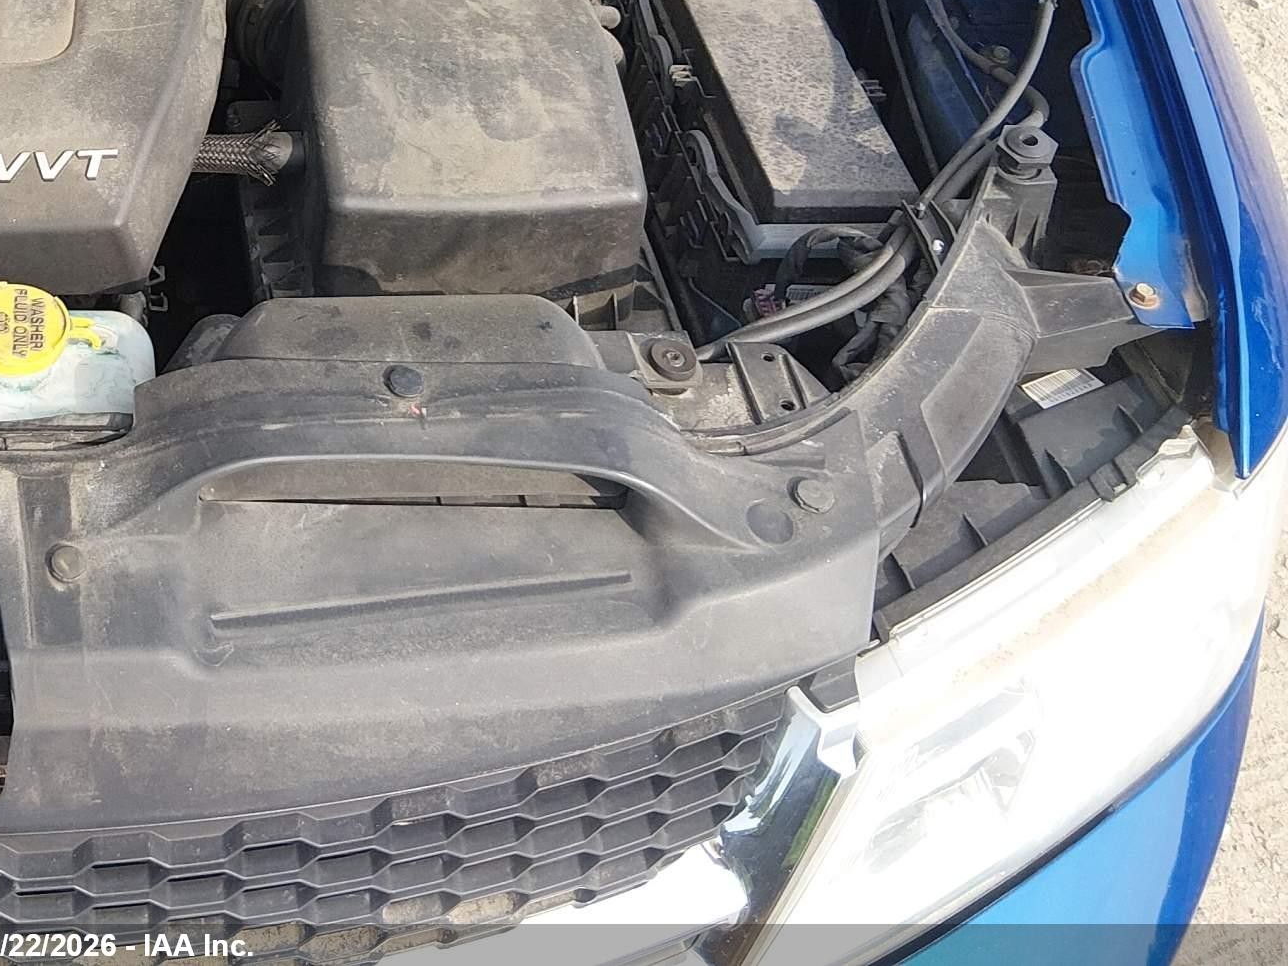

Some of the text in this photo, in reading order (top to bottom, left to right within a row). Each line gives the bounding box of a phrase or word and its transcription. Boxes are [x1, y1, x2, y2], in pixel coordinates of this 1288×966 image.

[12, 288, 28, 358] FLUID ONLY
[30, 297, 44, 351] WASHER
